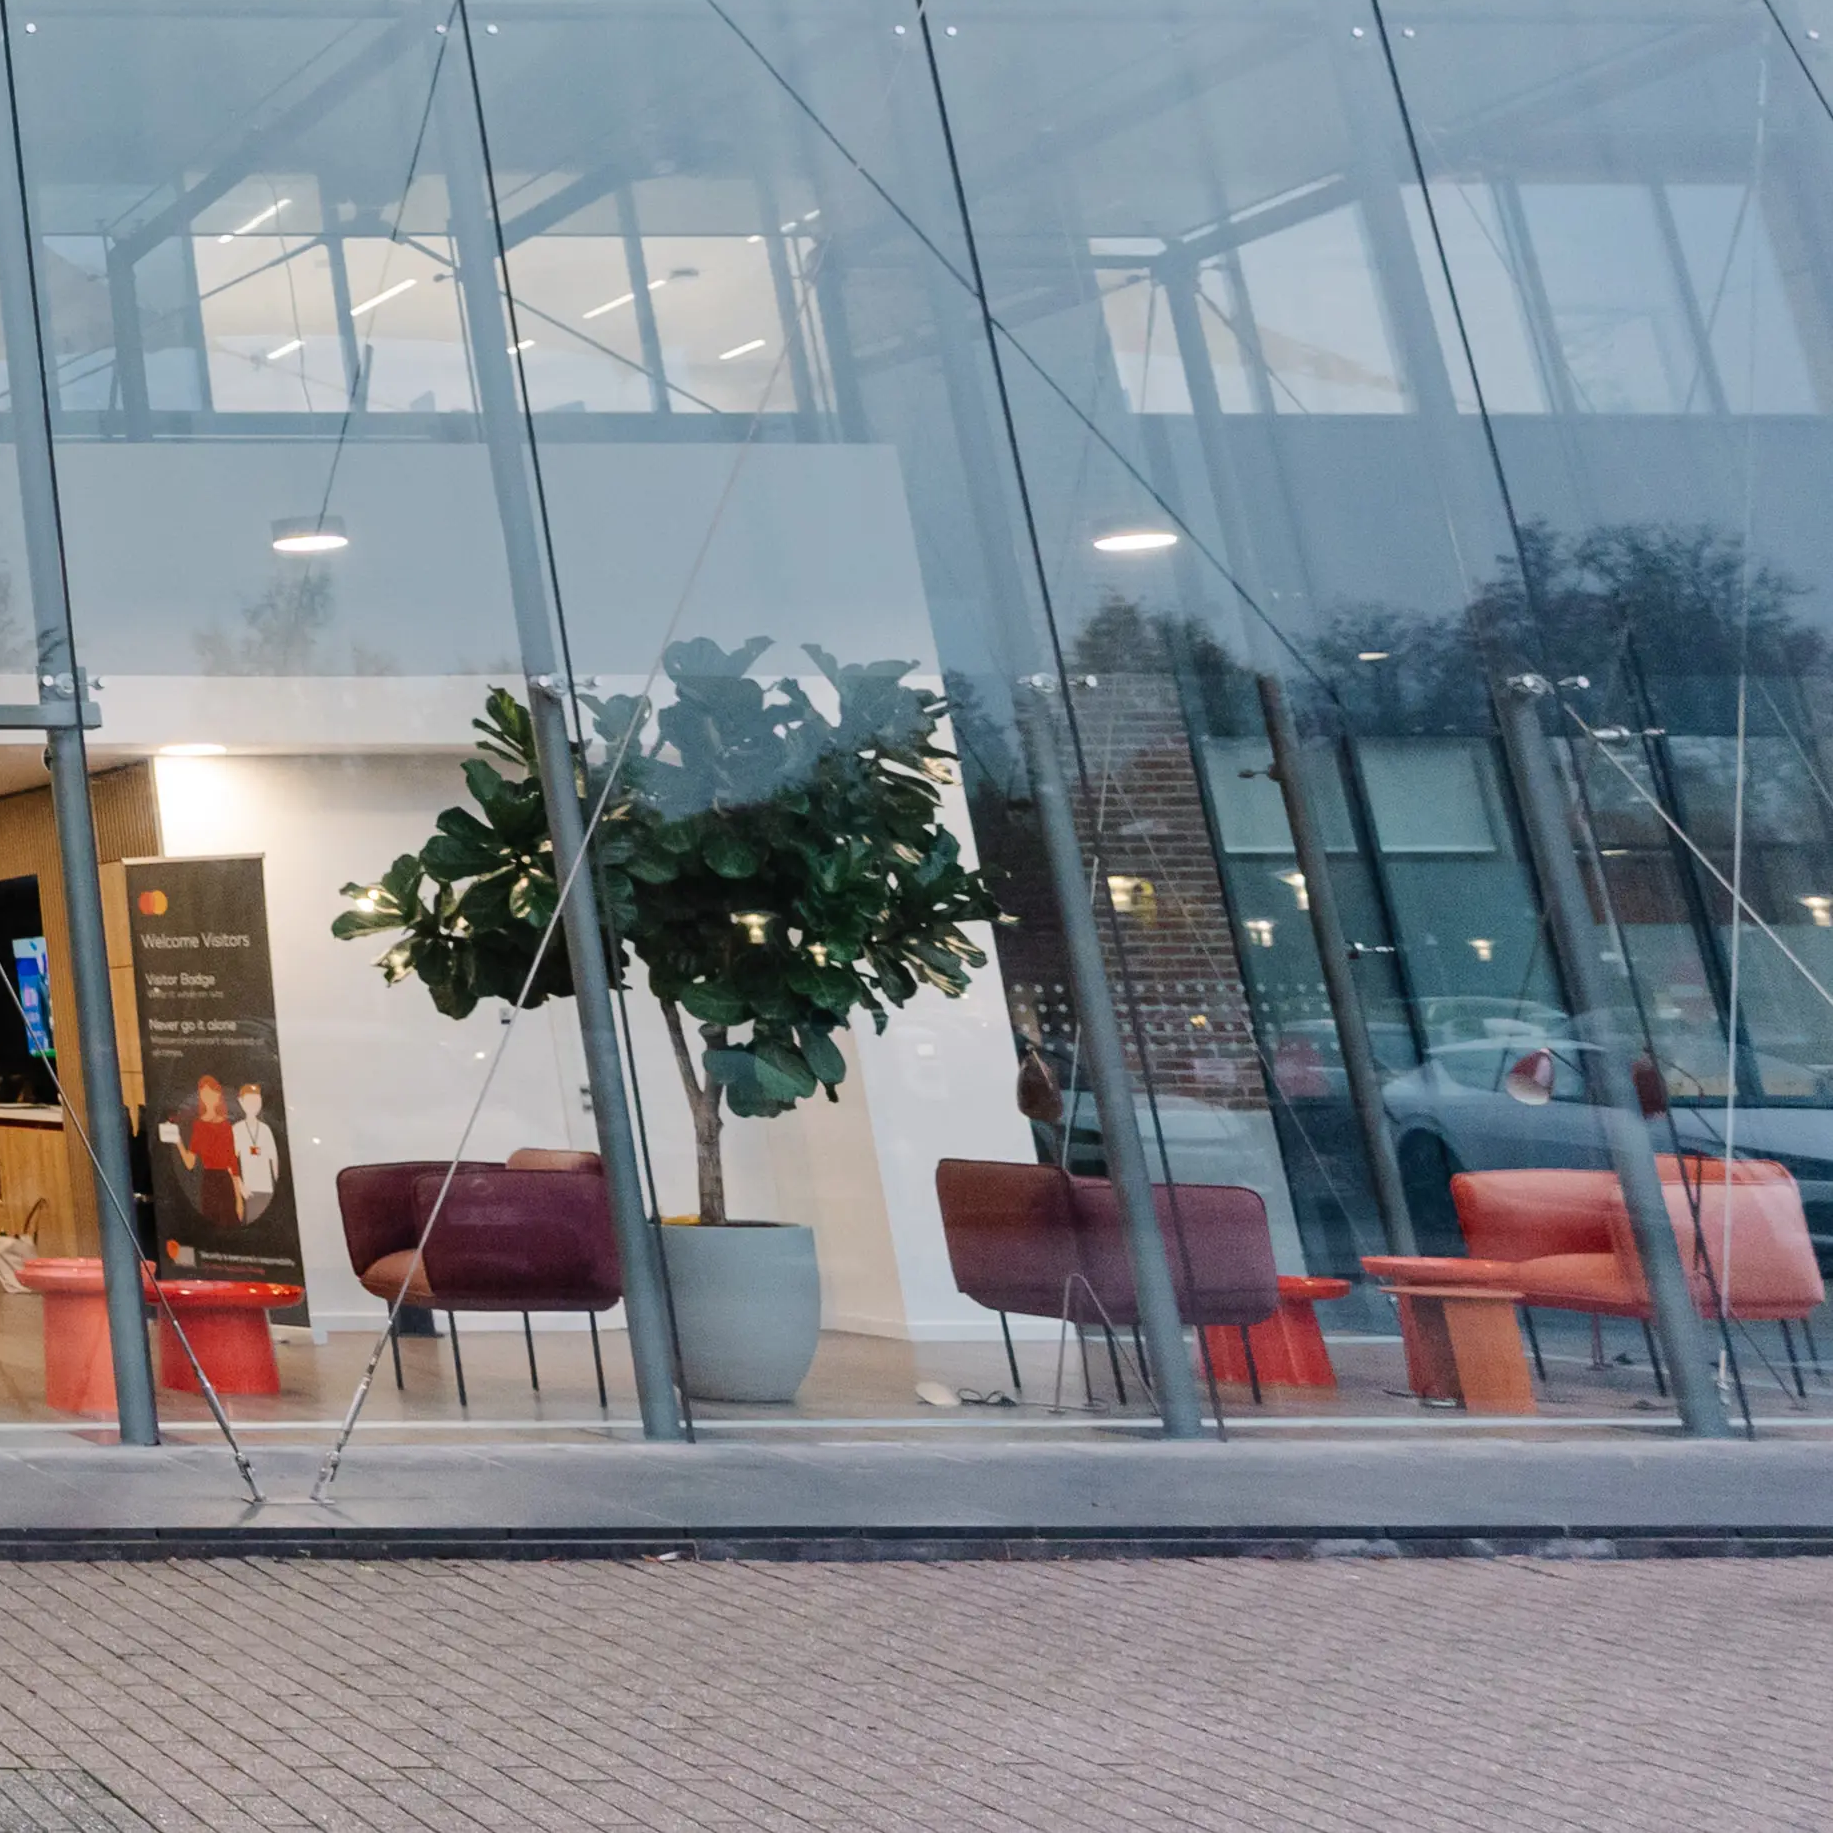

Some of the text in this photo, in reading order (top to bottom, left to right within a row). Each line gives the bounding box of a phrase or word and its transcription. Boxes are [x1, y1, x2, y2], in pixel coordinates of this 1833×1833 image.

[141, 932, 251, 949] Welcome Visitors
[144, 972, 216, 988] Visitor Badge
[148, 1019, 178, 1031] Never
[180, 1021, 195, 1034] go
[207, 1019, 237, 1031] alone
